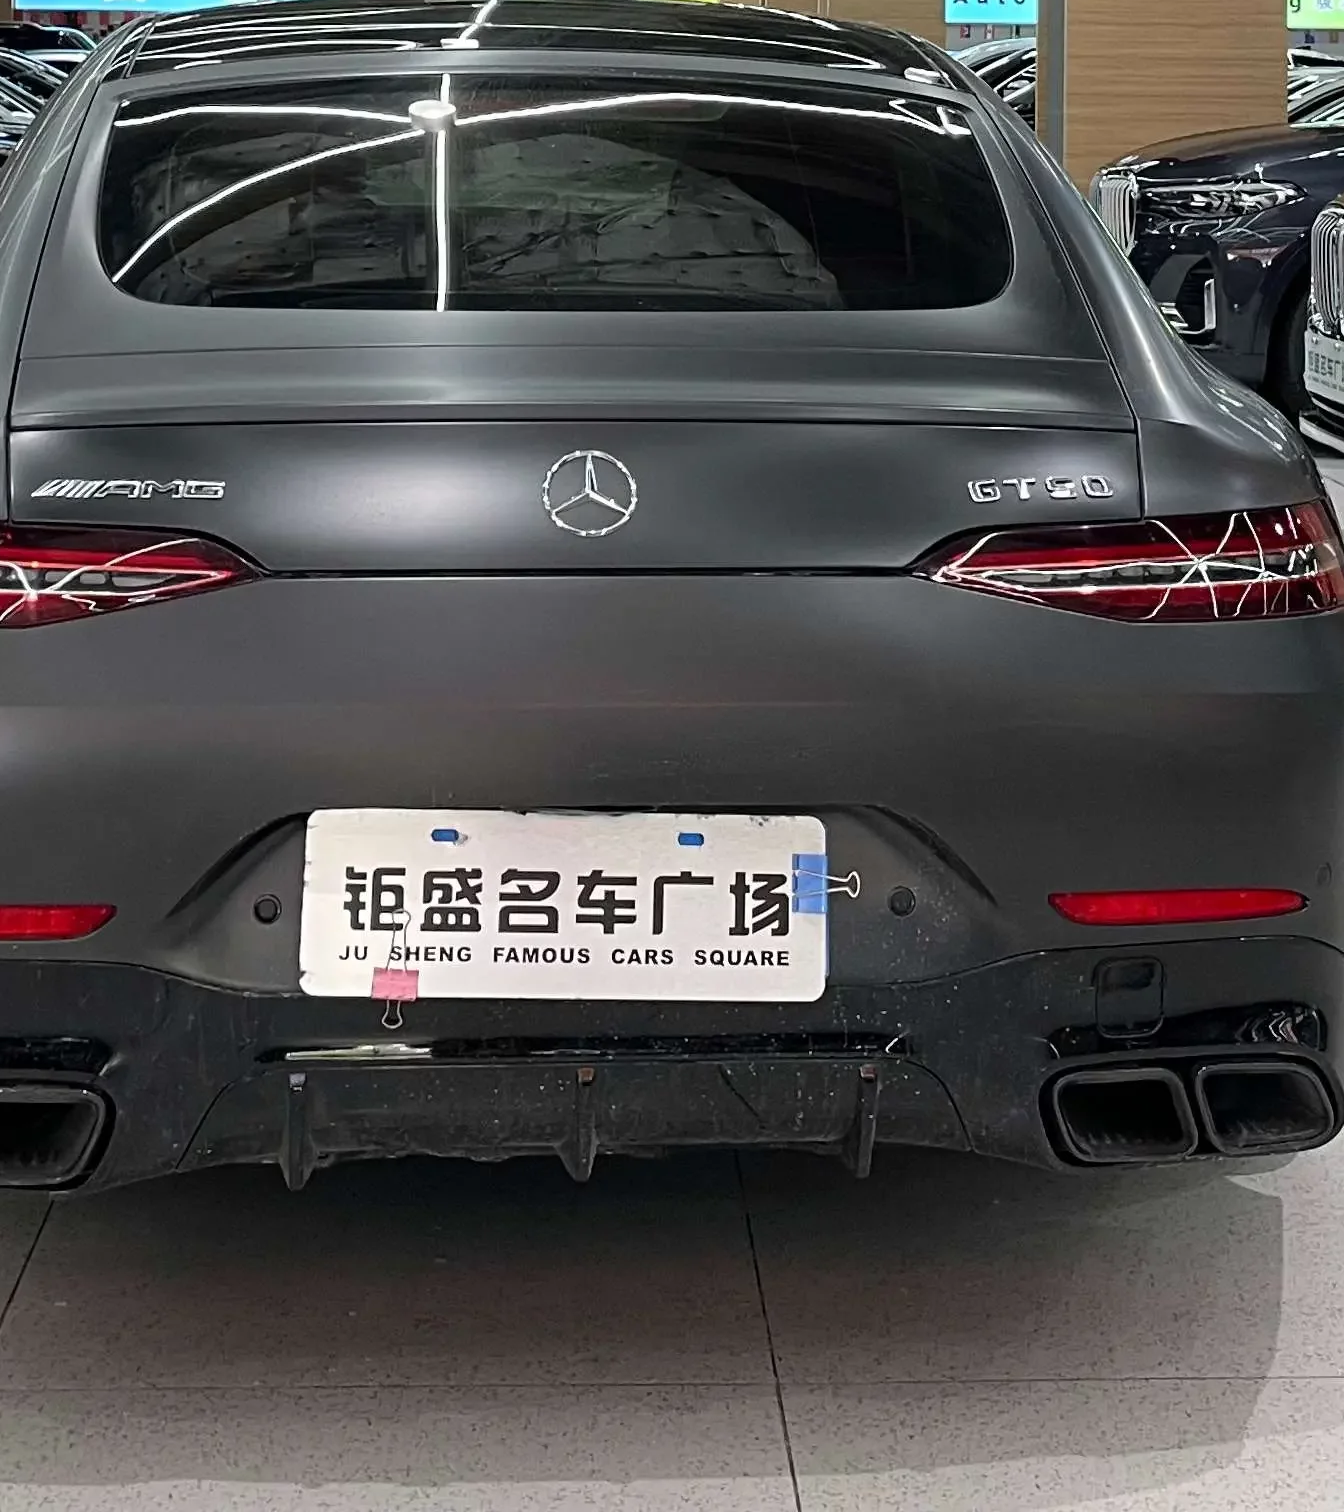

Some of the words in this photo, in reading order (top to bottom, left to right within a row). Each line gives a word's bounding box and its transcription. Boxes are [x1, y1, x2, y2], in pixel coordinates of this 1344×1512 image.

[94, 479, 226, 498] AMG
[343, 866, 790, 937] 钜盛名车广场
[339, 945, 369, 961] JU
[389, 945, 472, 963] SHENG
[493, 947, 591, 965] FAMOUS
[611, 948, 674, 966] CARS
[694, 949, 790, 968] SQUARE
